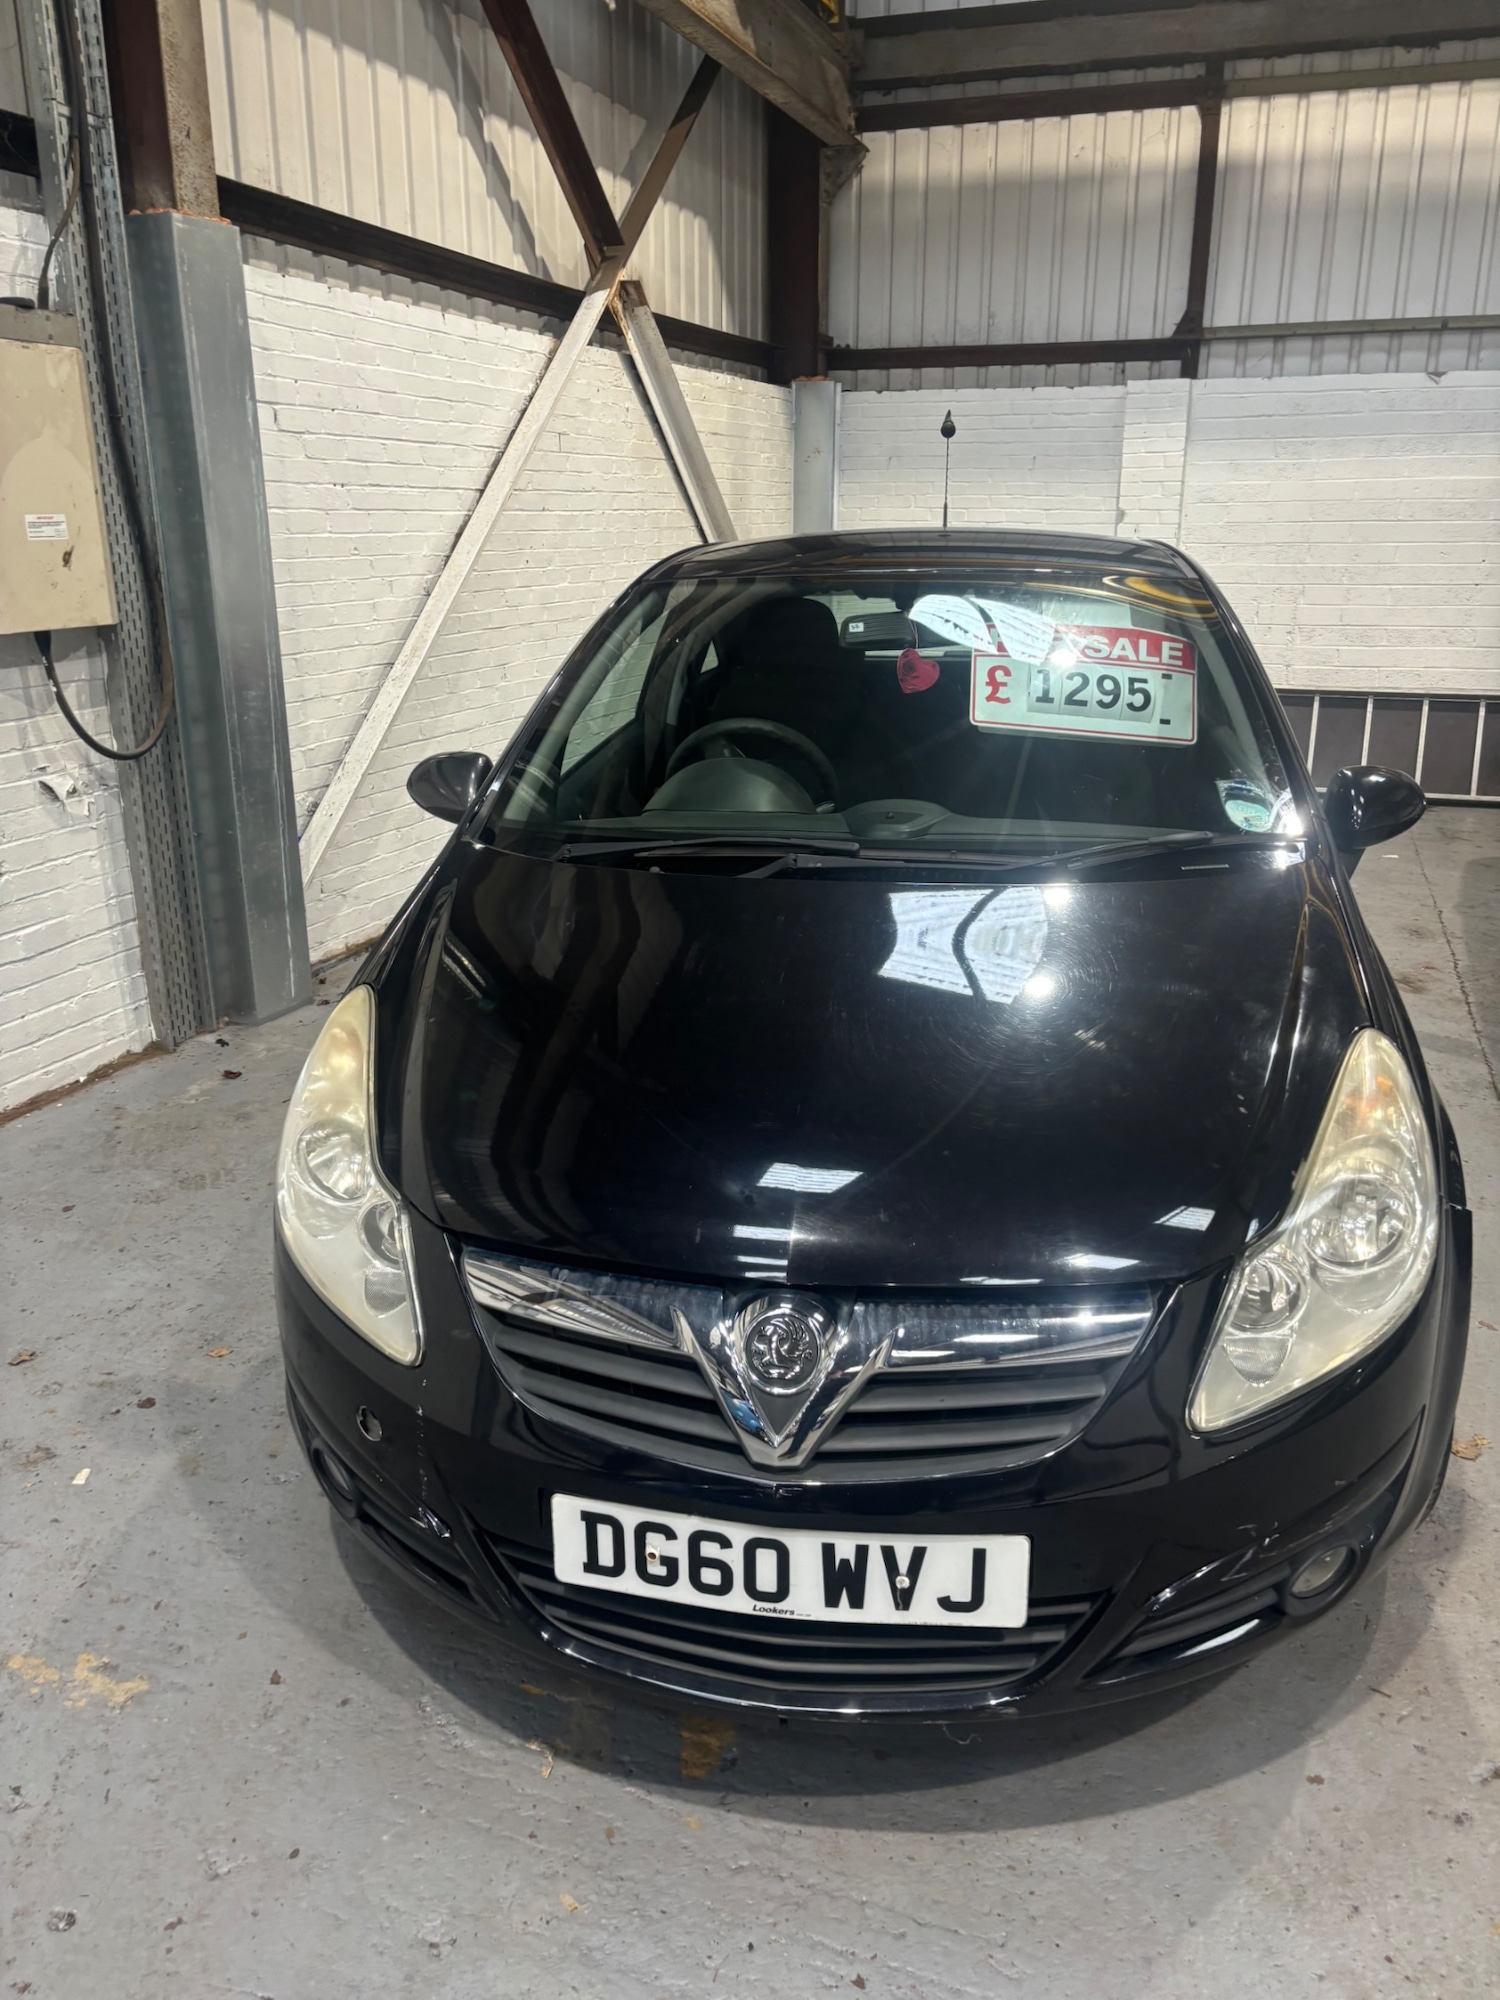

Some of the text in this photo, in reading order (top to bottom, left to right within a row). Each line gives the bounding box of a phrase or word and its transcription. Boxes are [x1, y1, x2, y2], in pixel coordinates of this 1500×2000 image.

[1084, 634, 1184, 666] SALE
[580, 1509, 987, 1613] DG60 WVJ
[752, 1604, 795, 1617] Lookers
